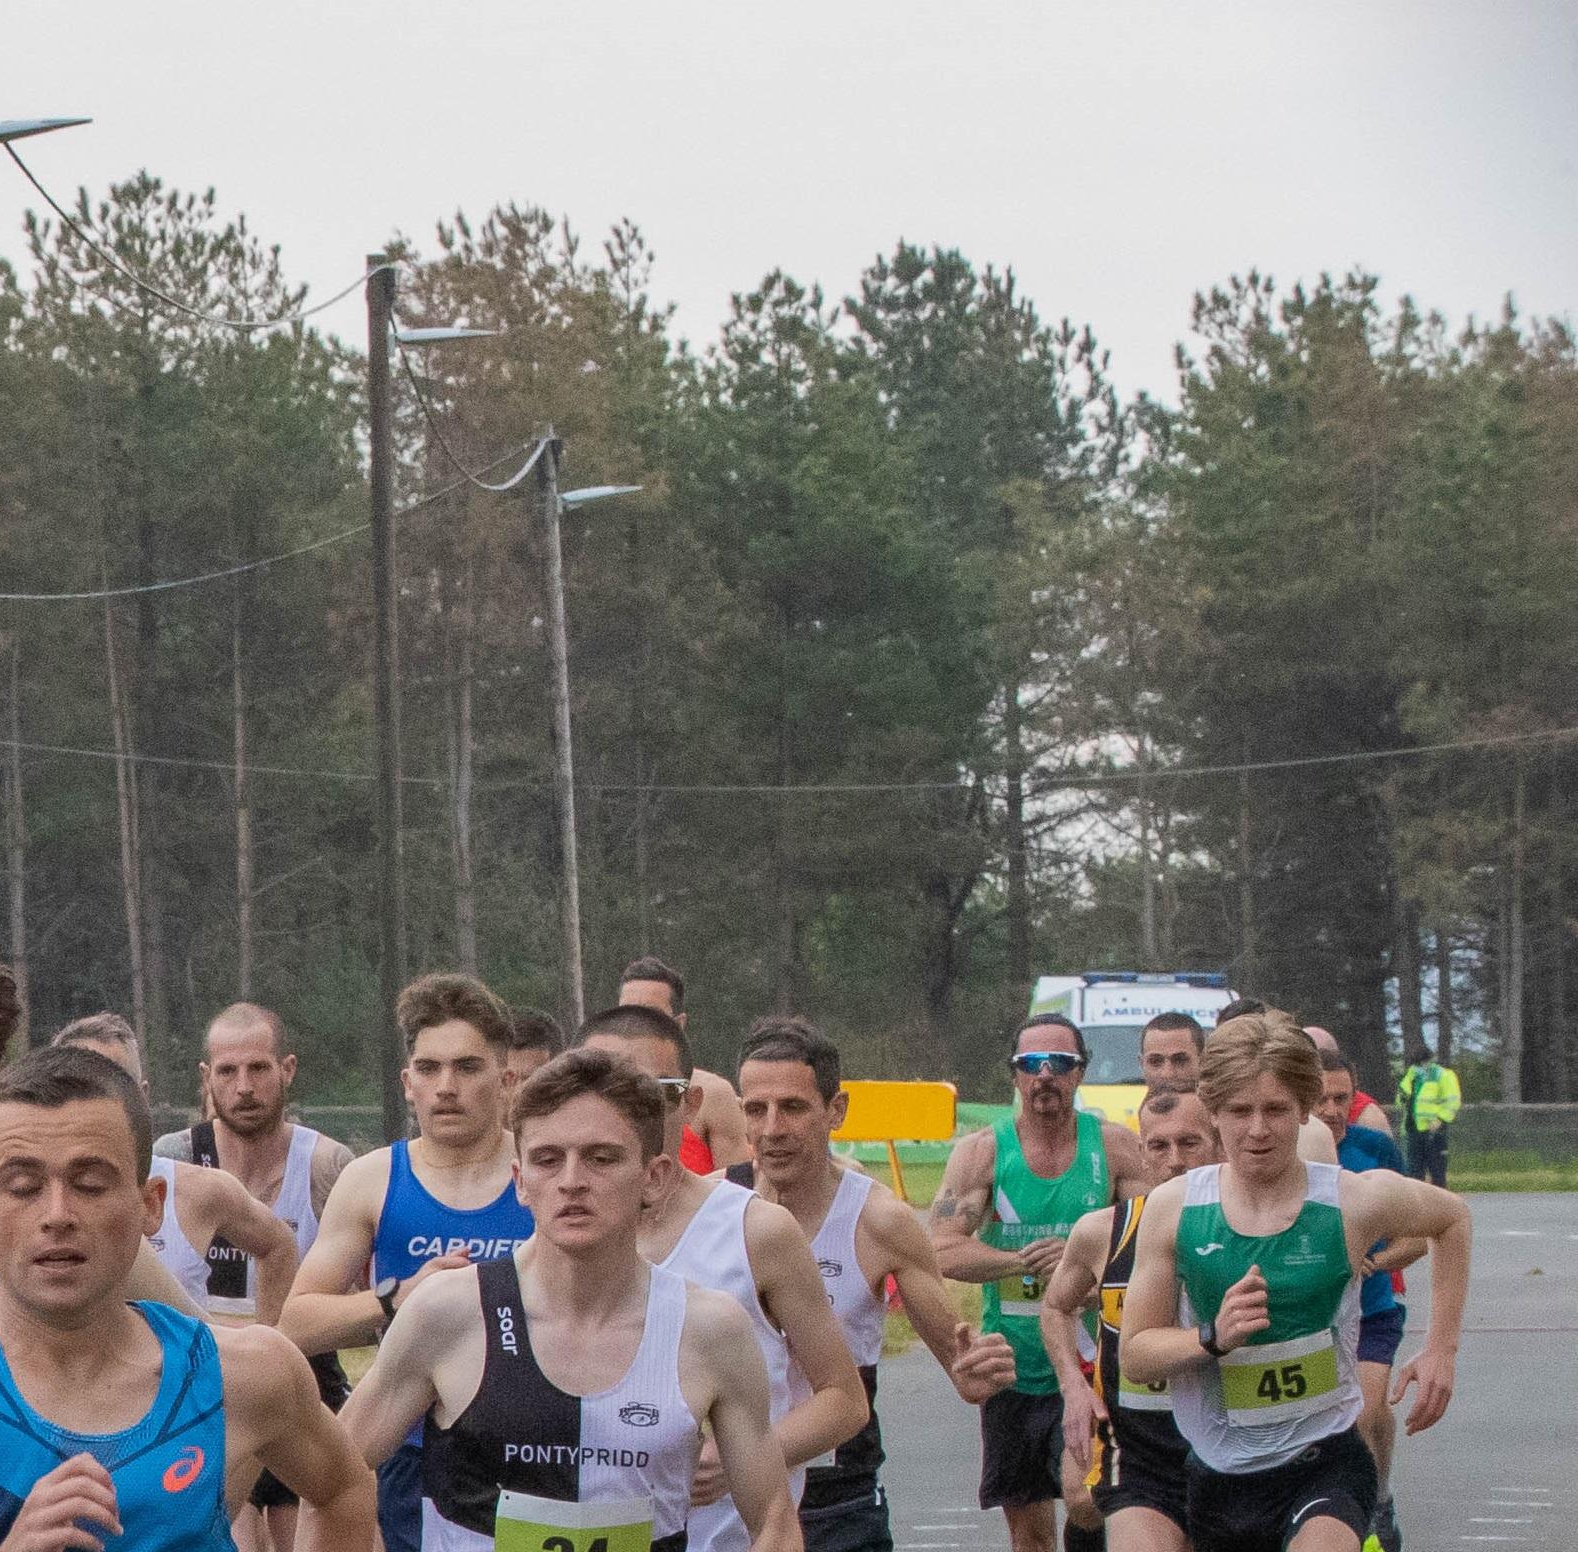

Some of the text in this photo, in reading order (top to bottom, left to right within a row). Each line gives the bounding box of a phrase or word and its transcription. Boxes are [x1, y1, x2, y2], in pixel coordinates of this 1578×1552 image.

[1102, 1006, 1219, 1018] AMBULANCE
[497, 1306, 519, 1356] soar
[1257, 1363, 1307, 1402] 45
[504, 1443, 649, 1468] PONTYPRIDD
